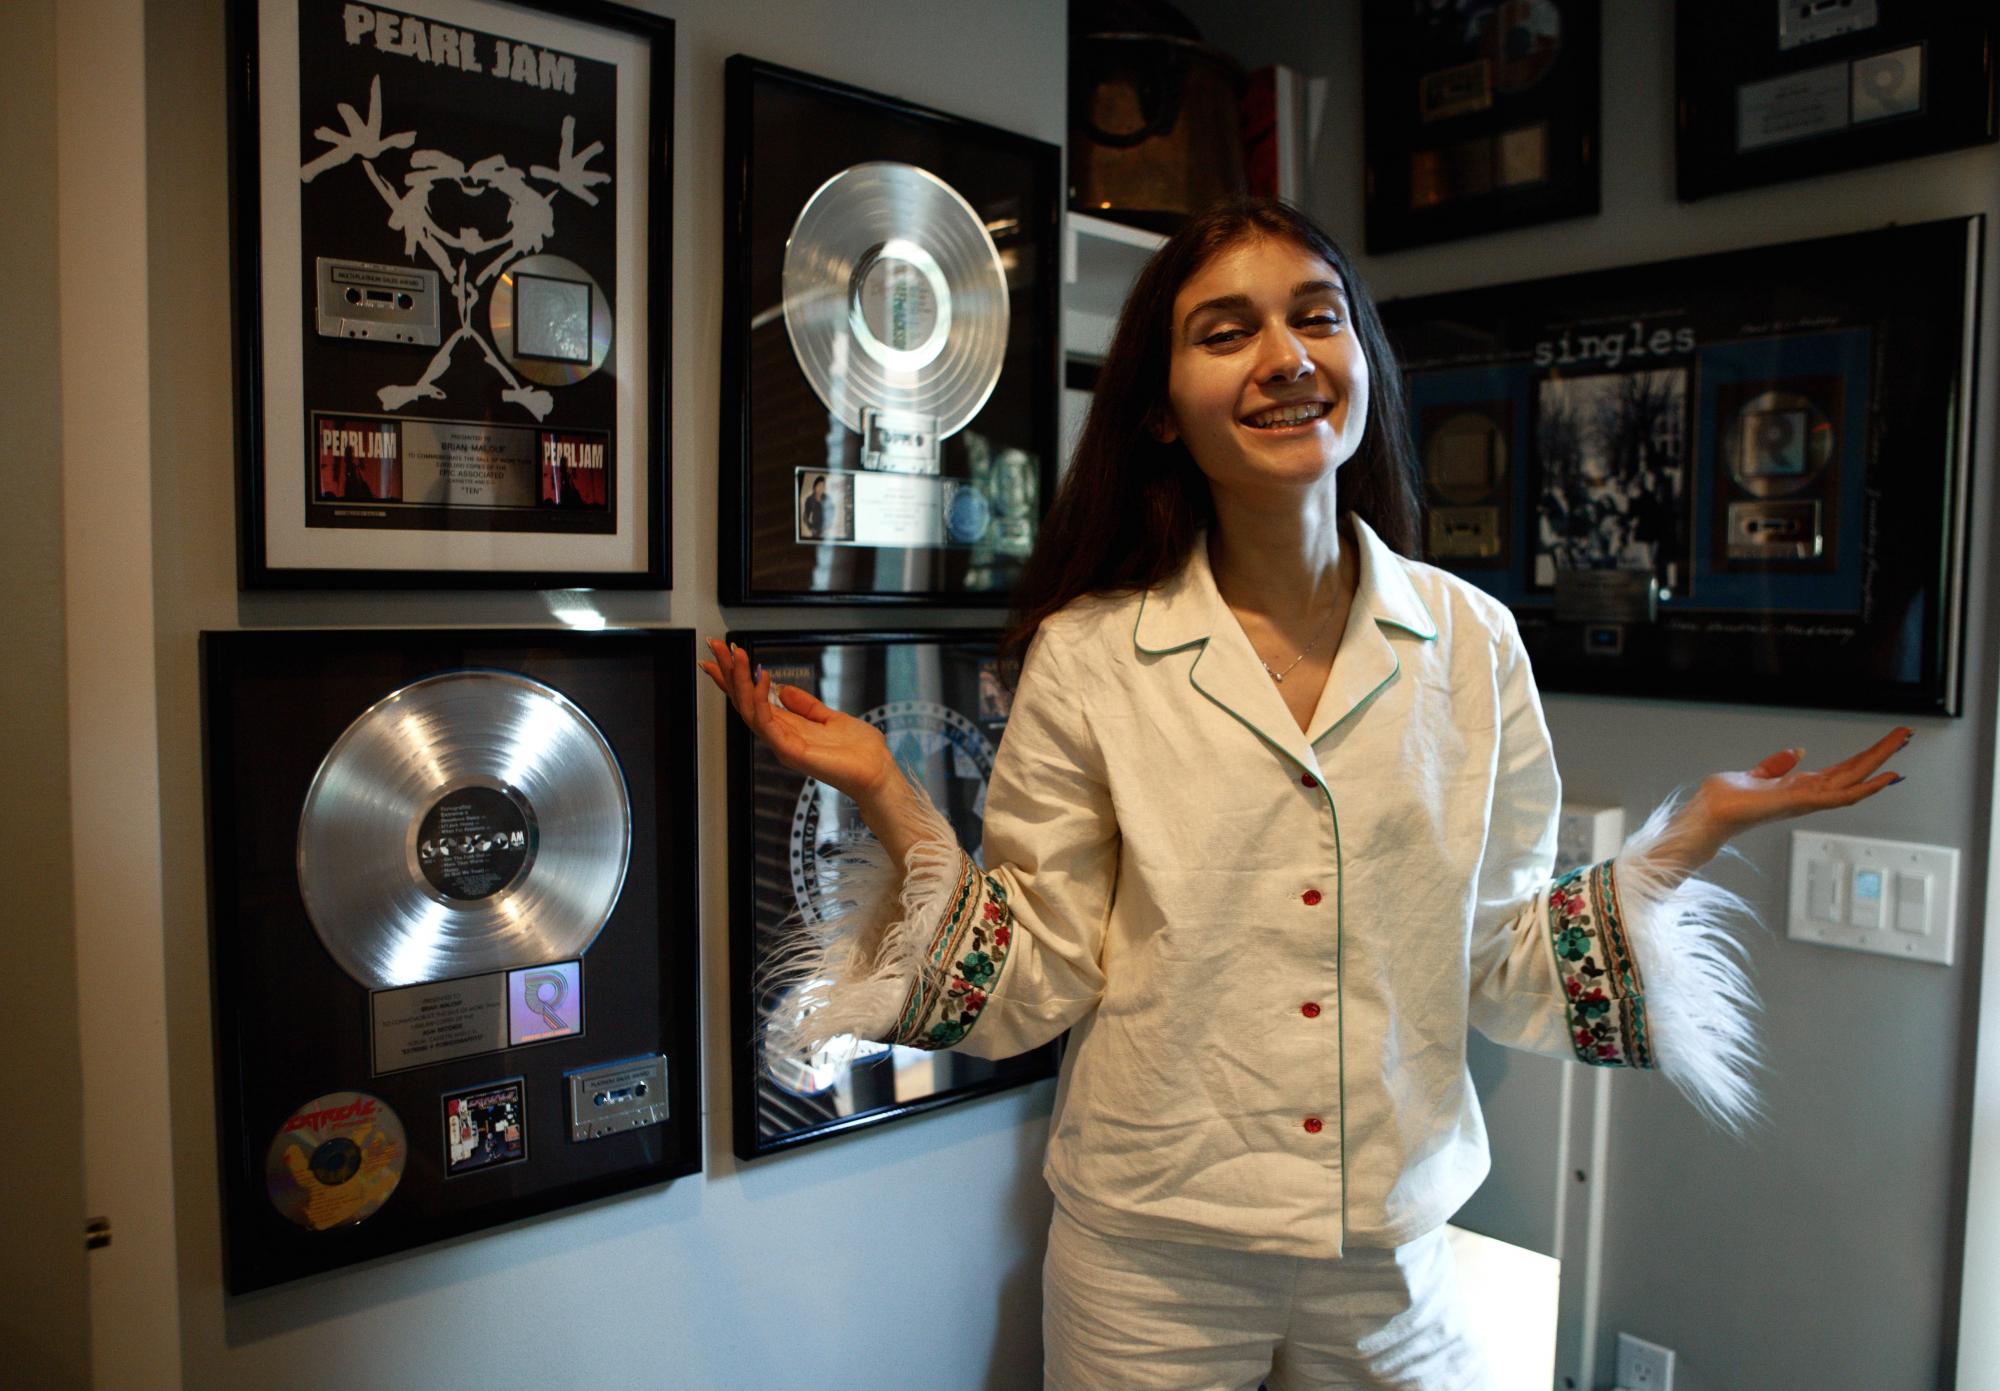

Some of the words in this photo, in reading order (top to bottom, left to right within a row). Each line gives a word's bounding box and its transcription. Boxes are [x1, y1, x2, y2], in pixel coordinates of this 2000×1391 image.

[343, 3, 482, 73] PEARL
[491, 40, 577, 95] JAM
[1534, 321, 1696, 368] singles
[322, 429, 365, 458] PEARL
[367, 431, 397, 459] JAM
[441, 442, 468, 452] BRIAN
[544, 441, 577, 468] PEARL
[579, 443, 604, 469] JAM
[458, 470, 505, 480] ASSOCIATED
